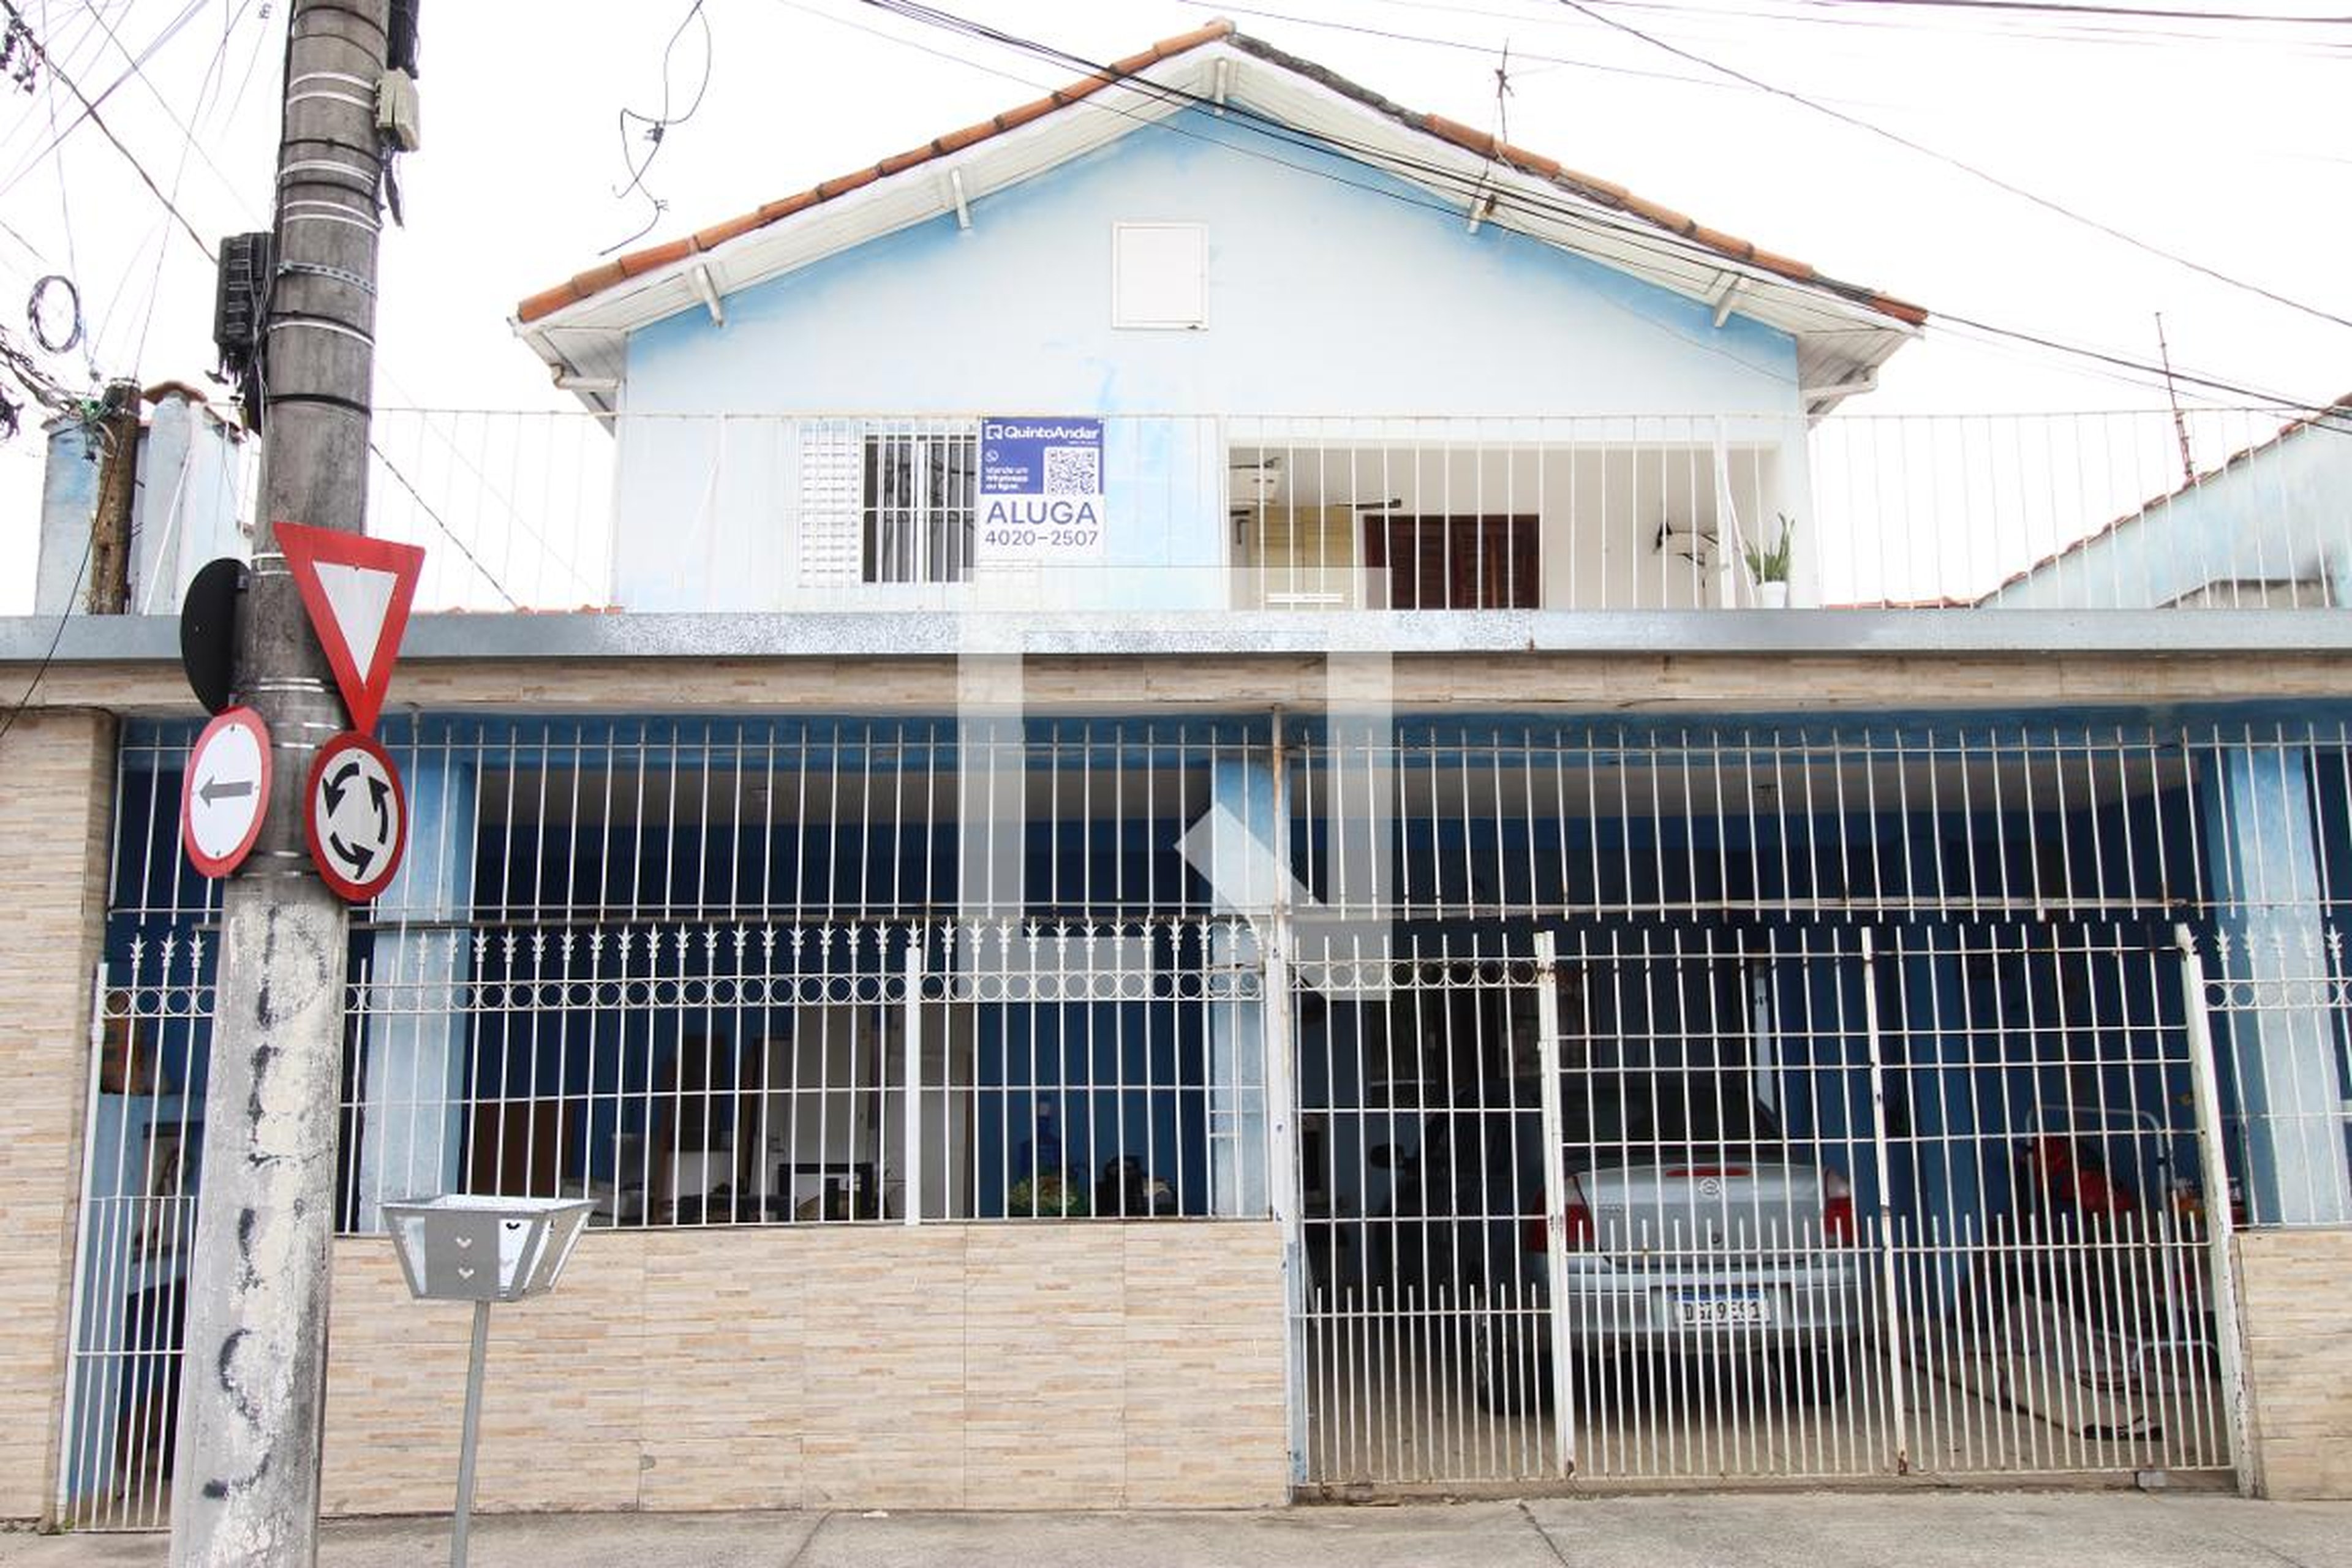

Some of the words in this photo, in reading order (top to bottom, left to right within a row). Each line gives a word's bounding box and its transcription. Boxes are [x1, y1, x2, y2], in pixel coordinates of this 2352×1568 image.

[1005, 426, 1099, 439] QuintoAndar
[986, 501, 1098, 525] ALUGA
[985, 530, 1098, 546] 4020-2507
